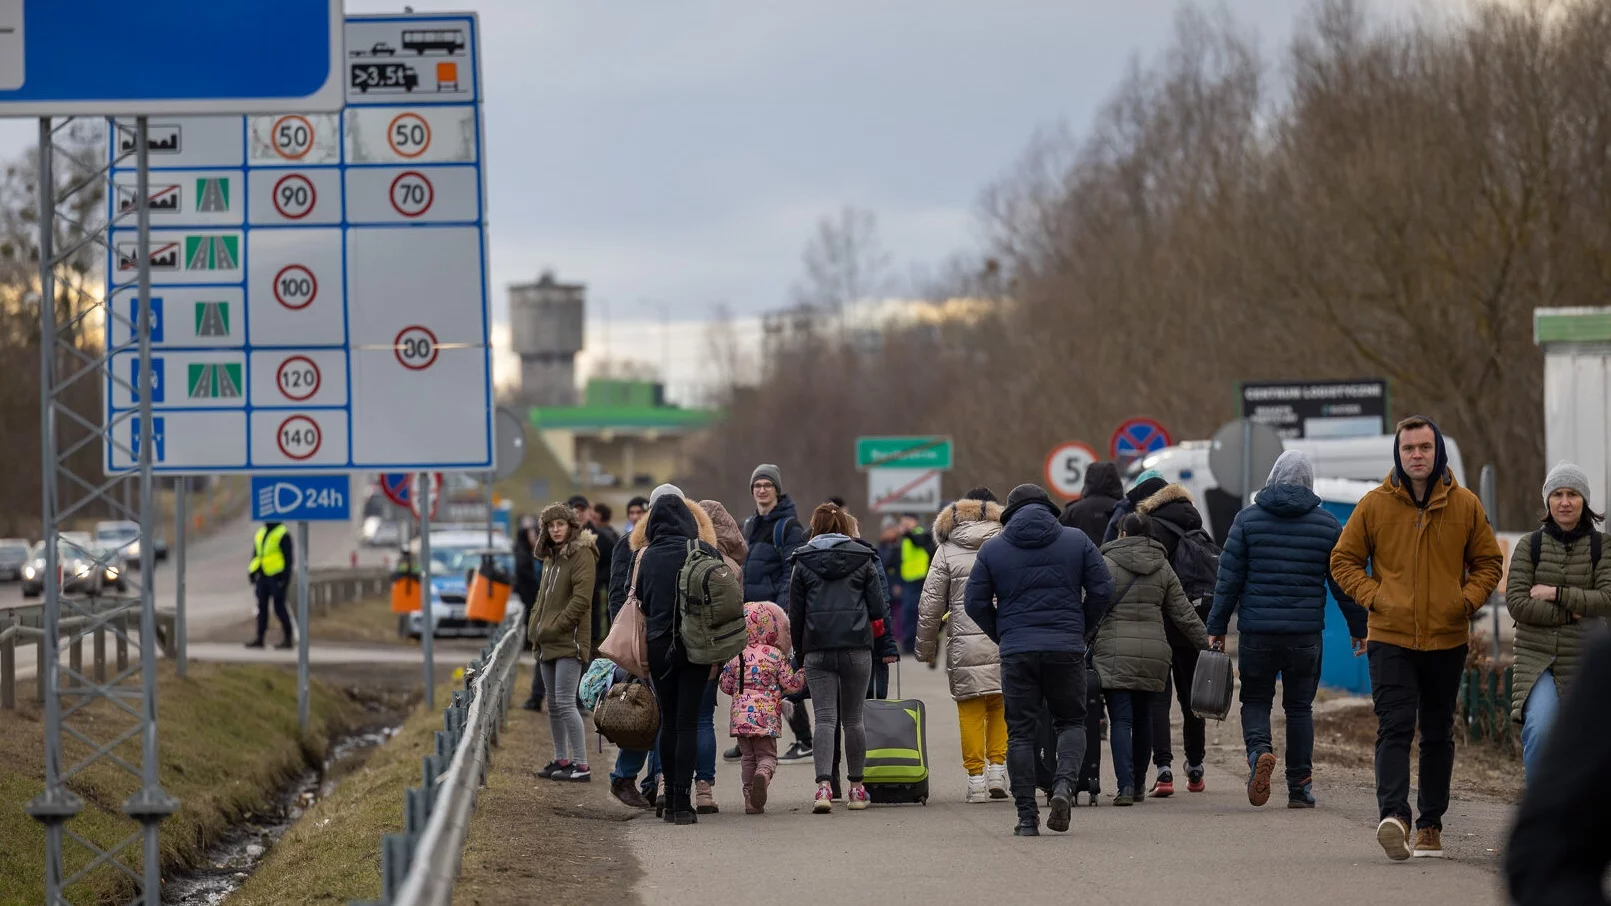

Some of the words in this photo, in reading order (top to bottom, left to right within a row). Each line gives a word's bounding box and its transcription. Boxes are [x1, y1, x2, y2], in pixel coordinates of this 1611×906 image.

[280, 126, 308, 148] 50
[396, 125, 425, 146] 50
[281, 186, 308, 207] 90
[401, 184, 425, 204] 70
[281, 278, 311, 297] 100
[403, 338, 430, 358] 30
[283, 370, 315, 388] 120
[283, 429, 316, 447] 140
[1064, 456, 1087, 485] 5
[305, 488, 343, 508] 24h
